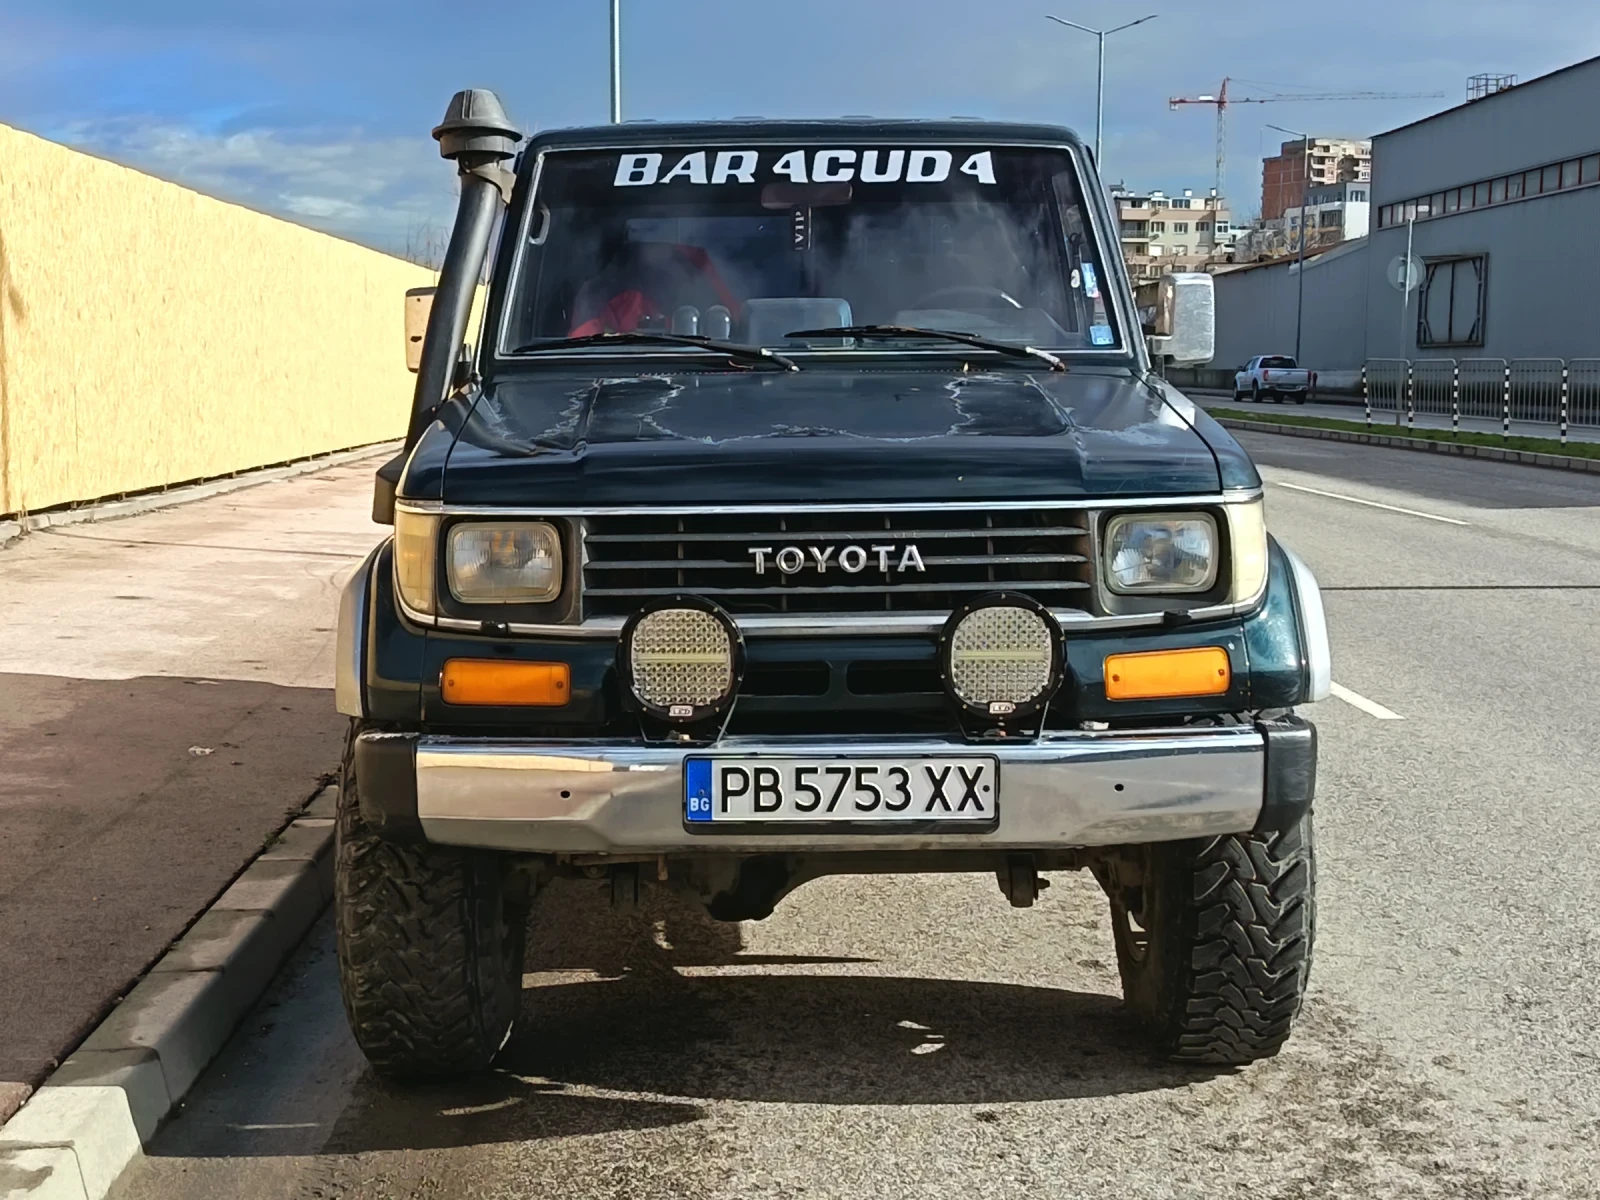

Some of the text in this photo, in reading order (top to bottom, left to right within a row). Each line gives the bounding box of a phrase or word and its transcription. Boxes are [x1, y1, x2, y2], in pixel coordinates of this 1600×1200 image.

[748, 544, 926, 575] TOYOTA
[690, 797, 710, 812] BG
[721, 766, 985, 813] PB 5753 XX
